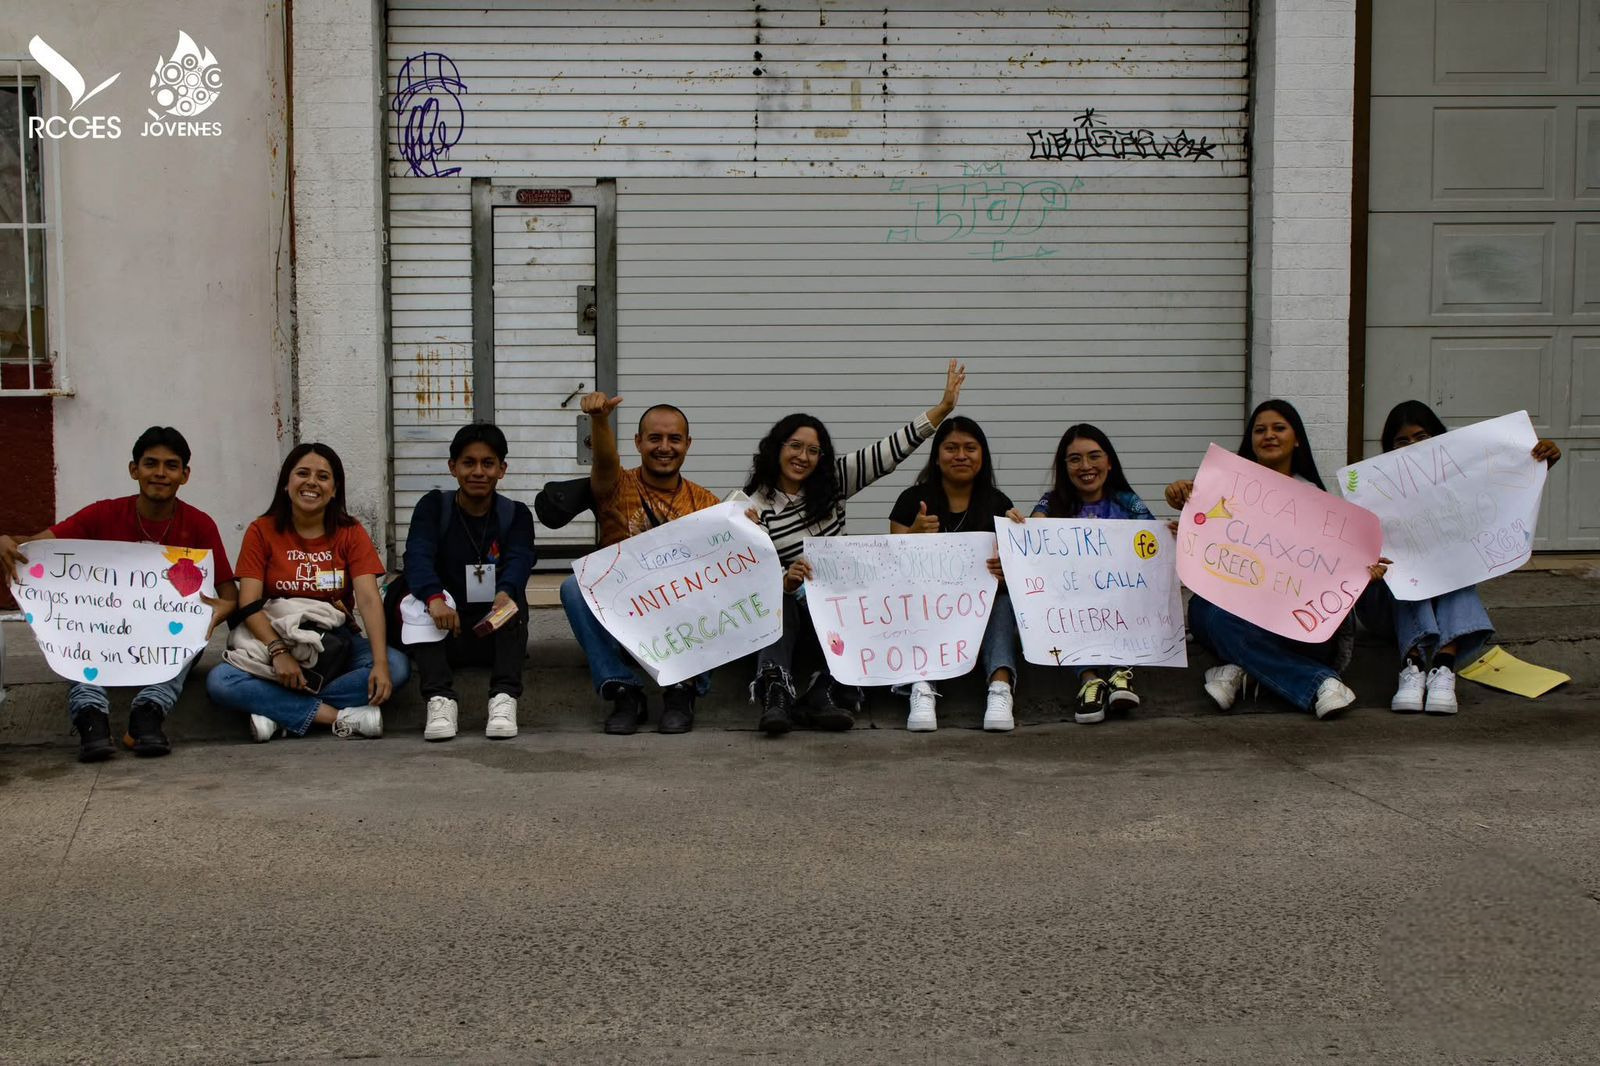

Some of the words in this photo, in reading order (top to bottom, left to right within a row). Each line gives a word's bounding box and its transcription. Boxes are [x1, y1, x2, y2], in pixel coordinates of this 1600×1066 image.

[1231, 471, 1297, 525] TOCA
[1322, 510, 1354, 546] EL
[706, 530, 735, 548] una
[1008, 526, 1113, 557] NUESTRA
[1225, 519, 1341, 576] CLAXÓN
[50, 552, 118, 587] Joven
[129, 570, 158, 588] no
[1062, 571, 1080, 591] SE
[1094, 569, 1149, 591] CALLA
[1203, 542, 1260, 586] CREES
[1272, 571, 1303, 598] EN
[276, 580, 299, 591] CON
[74, 591, 122, 609] miedo
[132, 597, 146, 610] al
[825, 590, 987, 628] TESTIGOS
[55, 612, 84, 632] ten
[90, 616, 132, 635] miedo
[1046, 607, 1129, 634] CELEBRA
[59, 642, 92, 661] vida
[100, 649, 123, 664] sin
[860, 640, 969, 676] PODER
